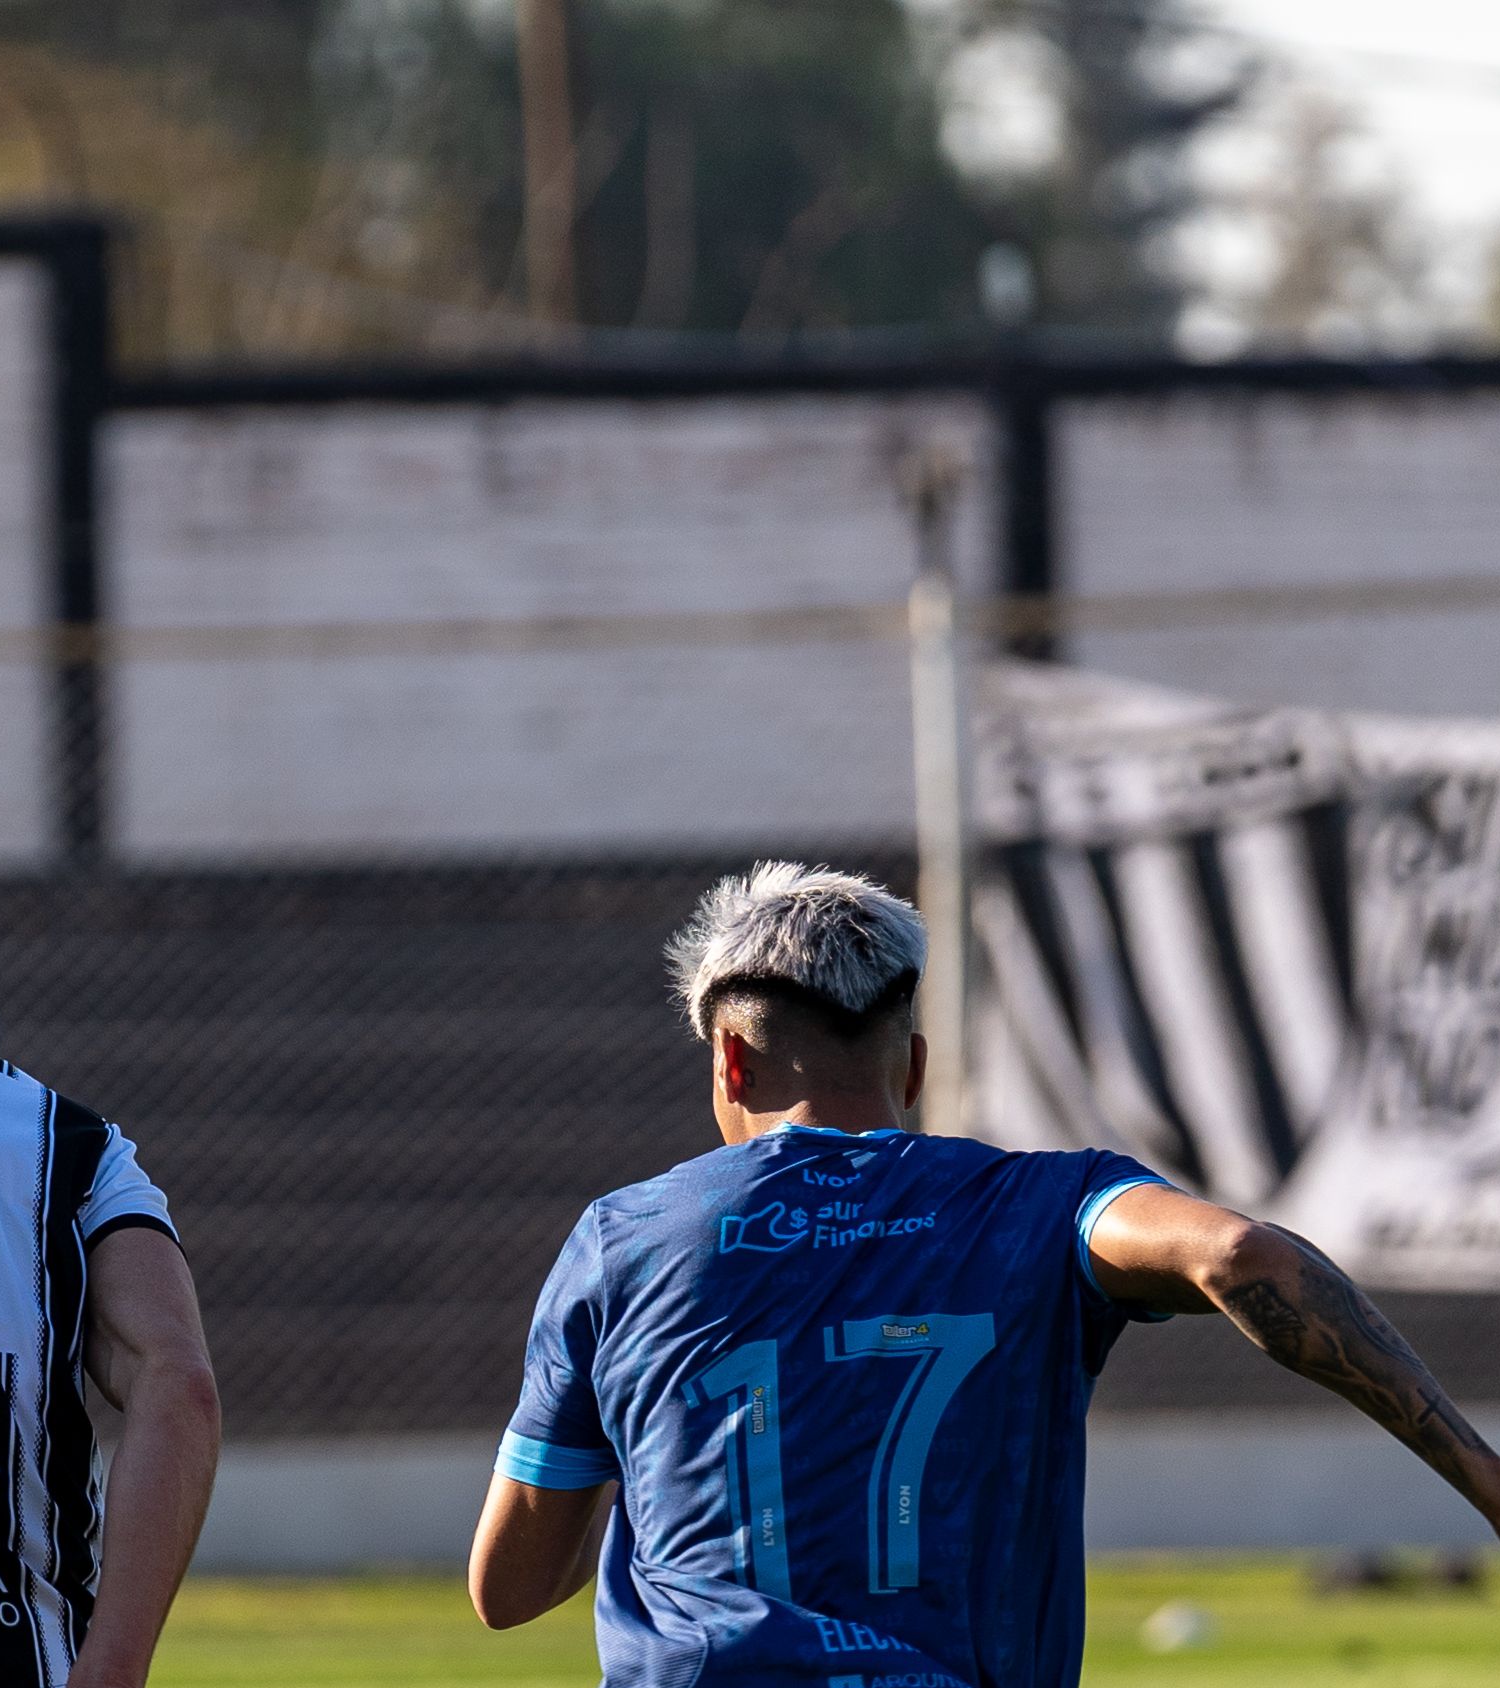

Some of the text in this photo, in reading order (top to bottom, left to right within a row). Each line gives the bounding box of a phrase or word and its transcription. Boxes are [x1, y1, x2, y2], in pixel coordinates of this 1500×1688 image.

[681, 1312, 997, 1603] 17
[899, 1484, 911, 1525] LYON
[763, 1507, 775, 1547] LYON
